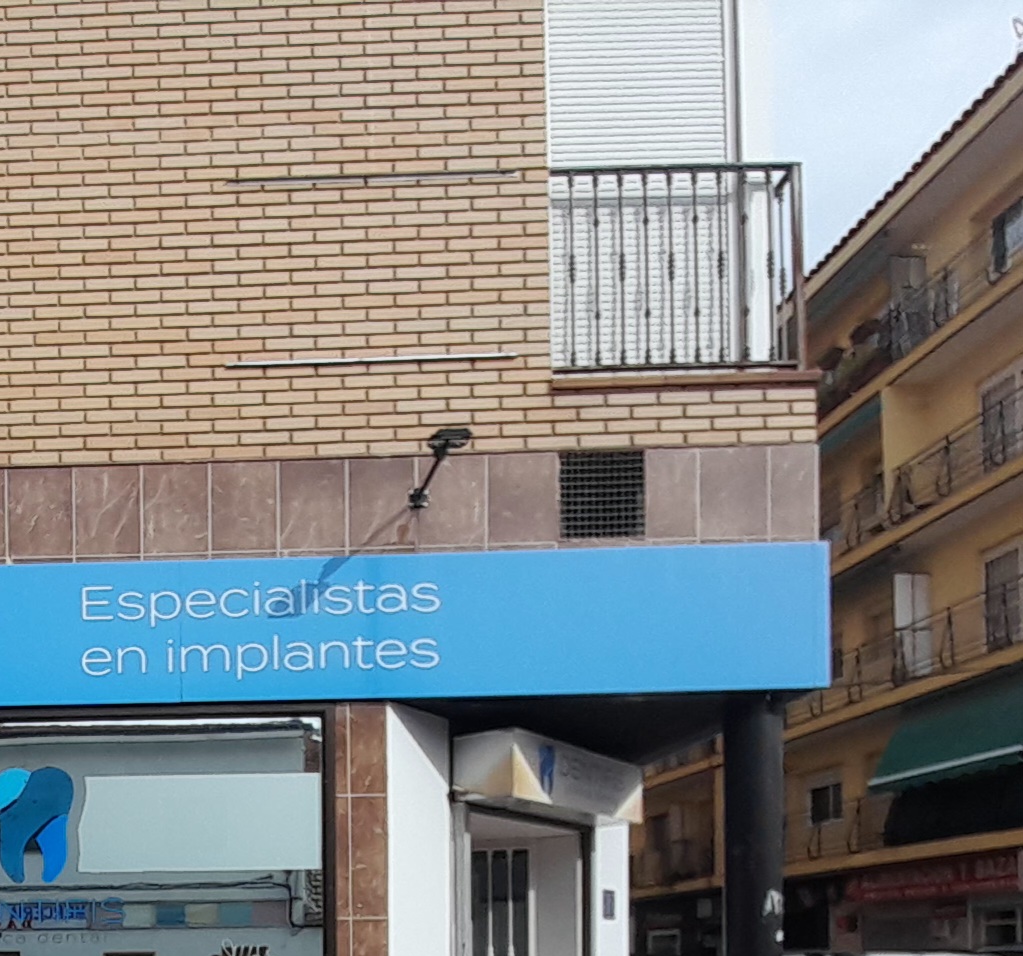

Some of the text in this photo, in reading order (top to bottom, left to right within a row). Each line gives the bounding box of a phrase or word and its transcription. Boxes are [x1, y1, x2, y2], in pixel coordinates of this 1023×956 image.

[80, 579, 441, 628] Especialistas
[80, 633, 441, 681] en implantes
